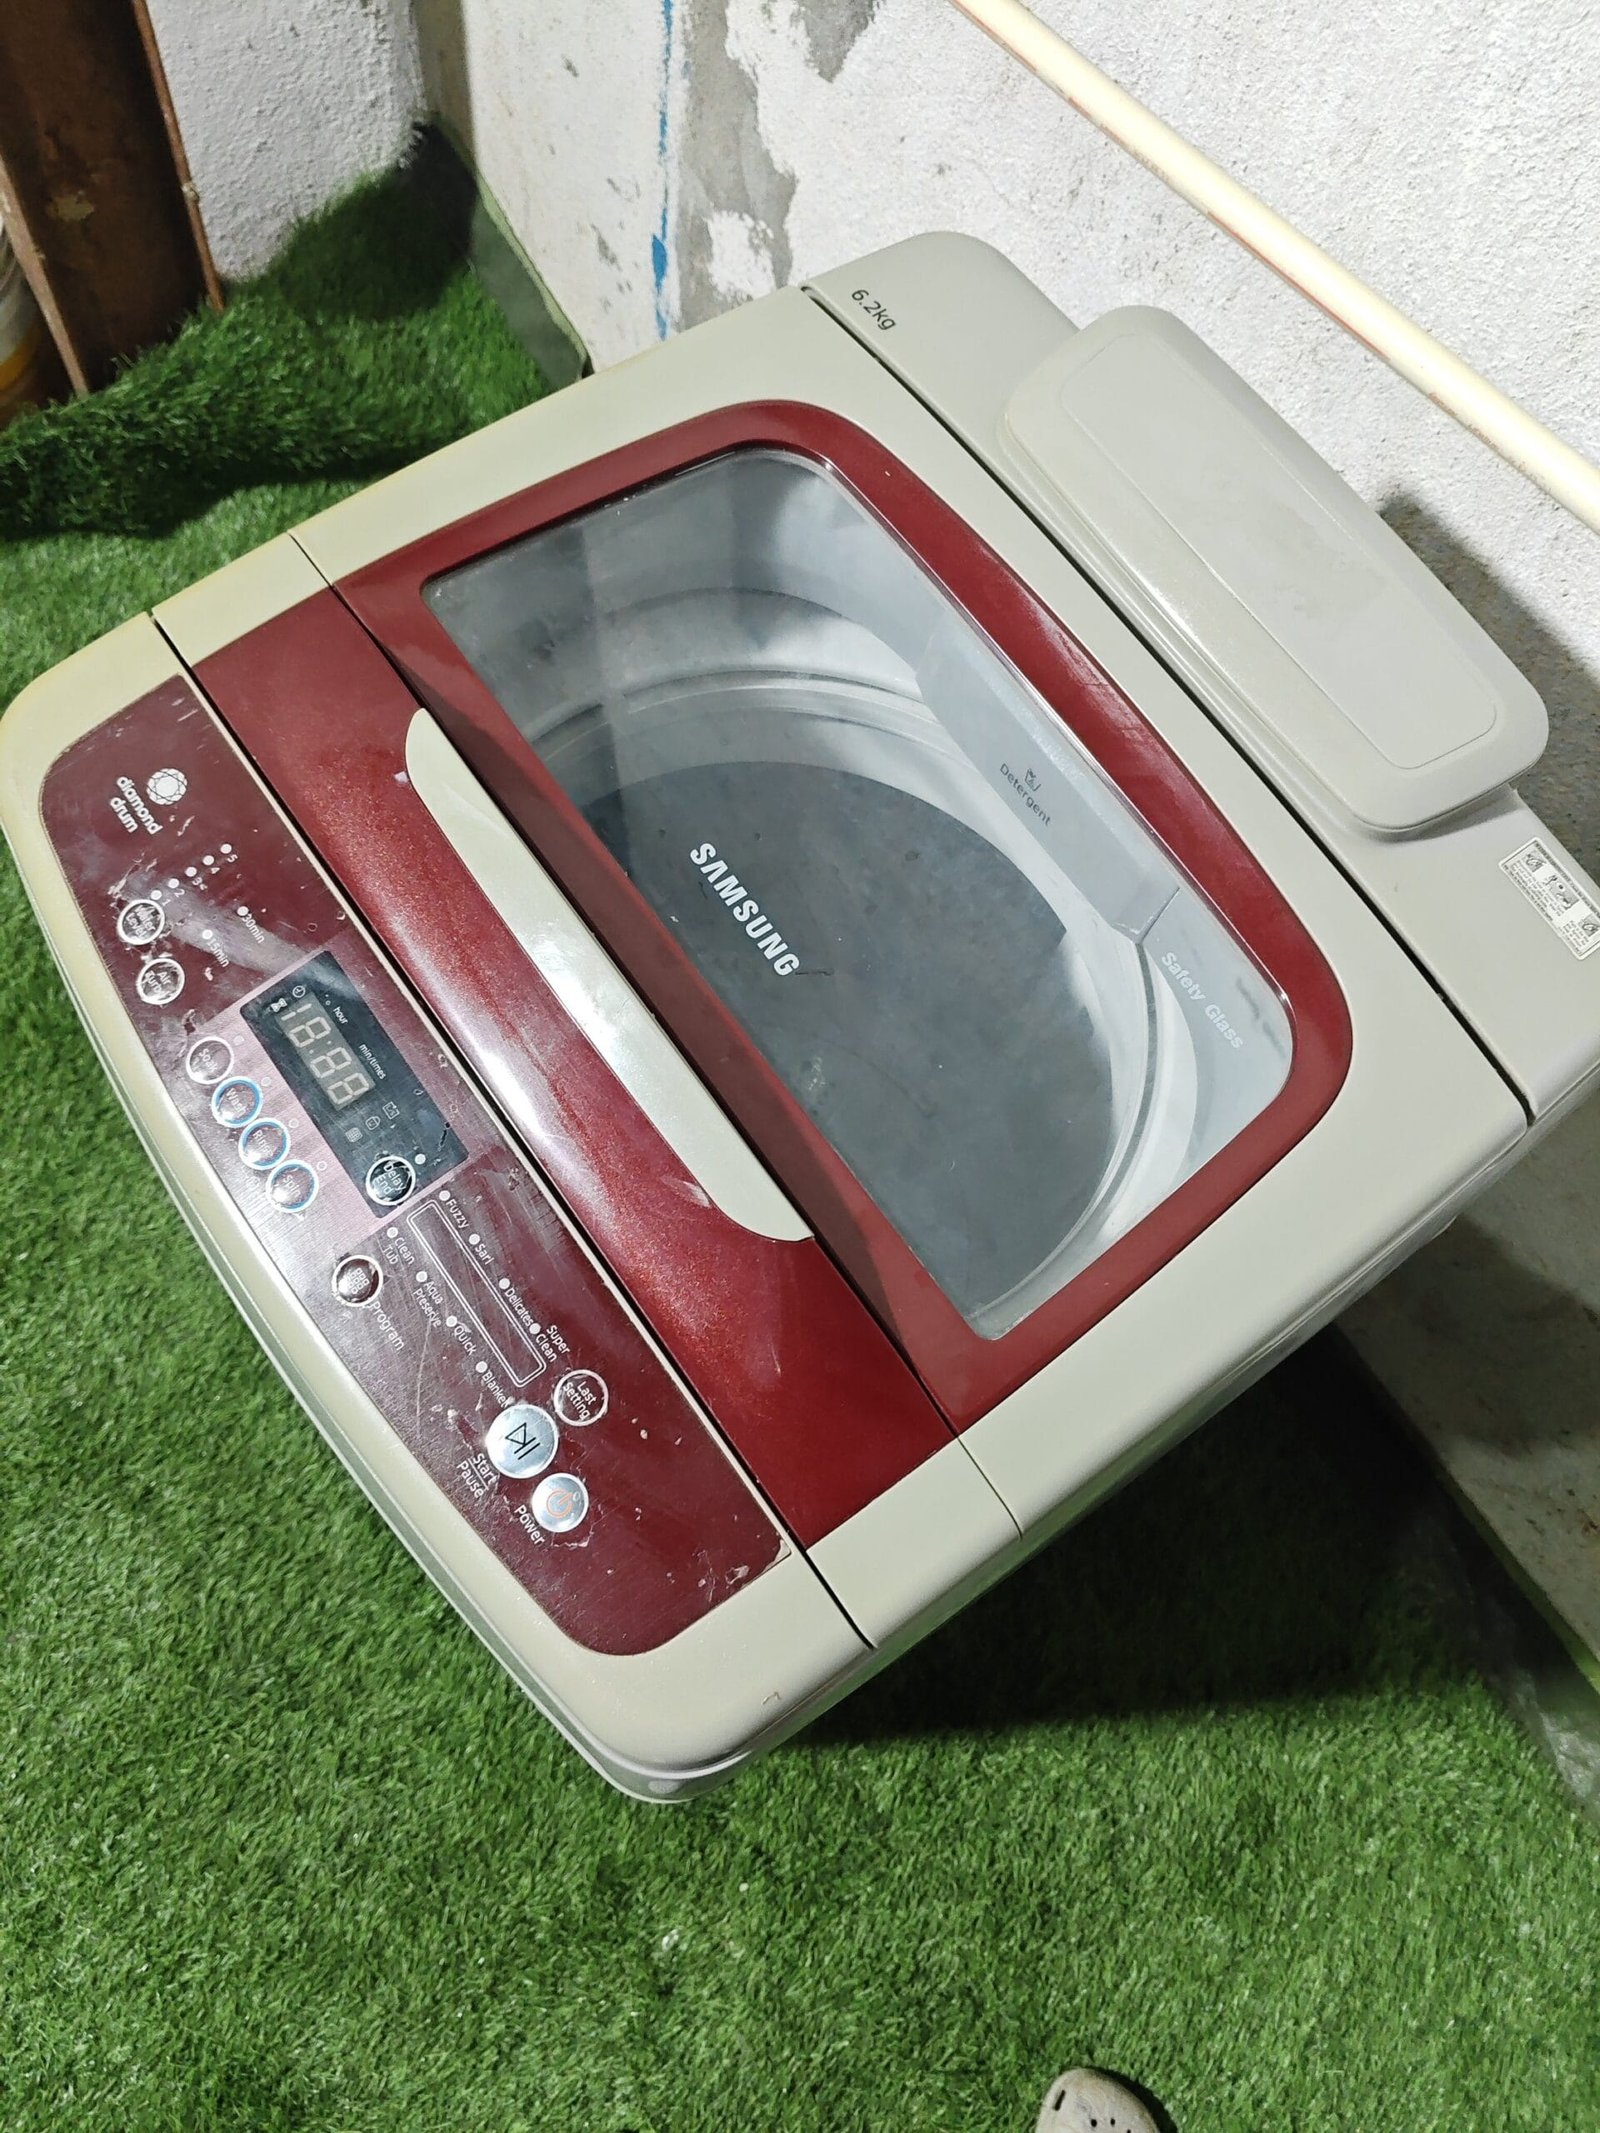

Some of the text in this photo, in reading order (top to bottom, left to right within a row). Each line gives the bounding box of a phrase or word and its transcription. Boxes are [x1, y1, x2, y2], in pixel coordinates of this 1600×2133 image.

[852, 290, 896, 330] 6.2kg
[116, 776, 163, 835] diamond
[1000, 763, 1051, 826] Detergent
[110, 797, 138, 833] drum
[210, 867, 220, 875] 4
[226, 854, 238, 863] 5
[174, 889, 185, 898] 2
[192, 877, 202, 886] 3
[161, 898, 171, 907] 1
[689, 842, 801, 976] SAMSUNG
[126, 912, 147, 938] Level
[242, 913, 265, 944] 30min
[207, 938, 230, 968] 15min
[157, 971, 172, 986] Air
[333, 1006, 349, 1024] hour
[1162, 952, 1243, 1048] Safety Glass
[198, 1048, 218, 1073] Soak
[358, 1043, 386, 1080] min/times
[226, 1088, 247, 1118] Wash
[282, 1174, 301, 1198] Spin
[374, 1176, 393, 1195] End
[383, 1161, 406, 1192] Delay
[446, 1198, 470, 1229] Fuzzy
[382, 1245, 399, 1265] Tub
[394, 1237, 415, 1265] Clean
[413, 1288, 442, 1328] Preserve
[423, 1280, 443, 1305] Aqua
[503, 1286, 535, 1327] Delicates
[370, 1300, 405, 1351] Program
[454, 1325, 477, 1356] Quick
[546, 1325, 571, 1355] Super
[535, 1332, 558, 1363] Clean
[563, 1381, 591, 1421] Setting
[577, 1380, 597, 1406] Last
[456, 1460, 485, 1499] Pause
[473, 1452, 499, 1485] Start
[514, 1504, 546, 1546] Power
